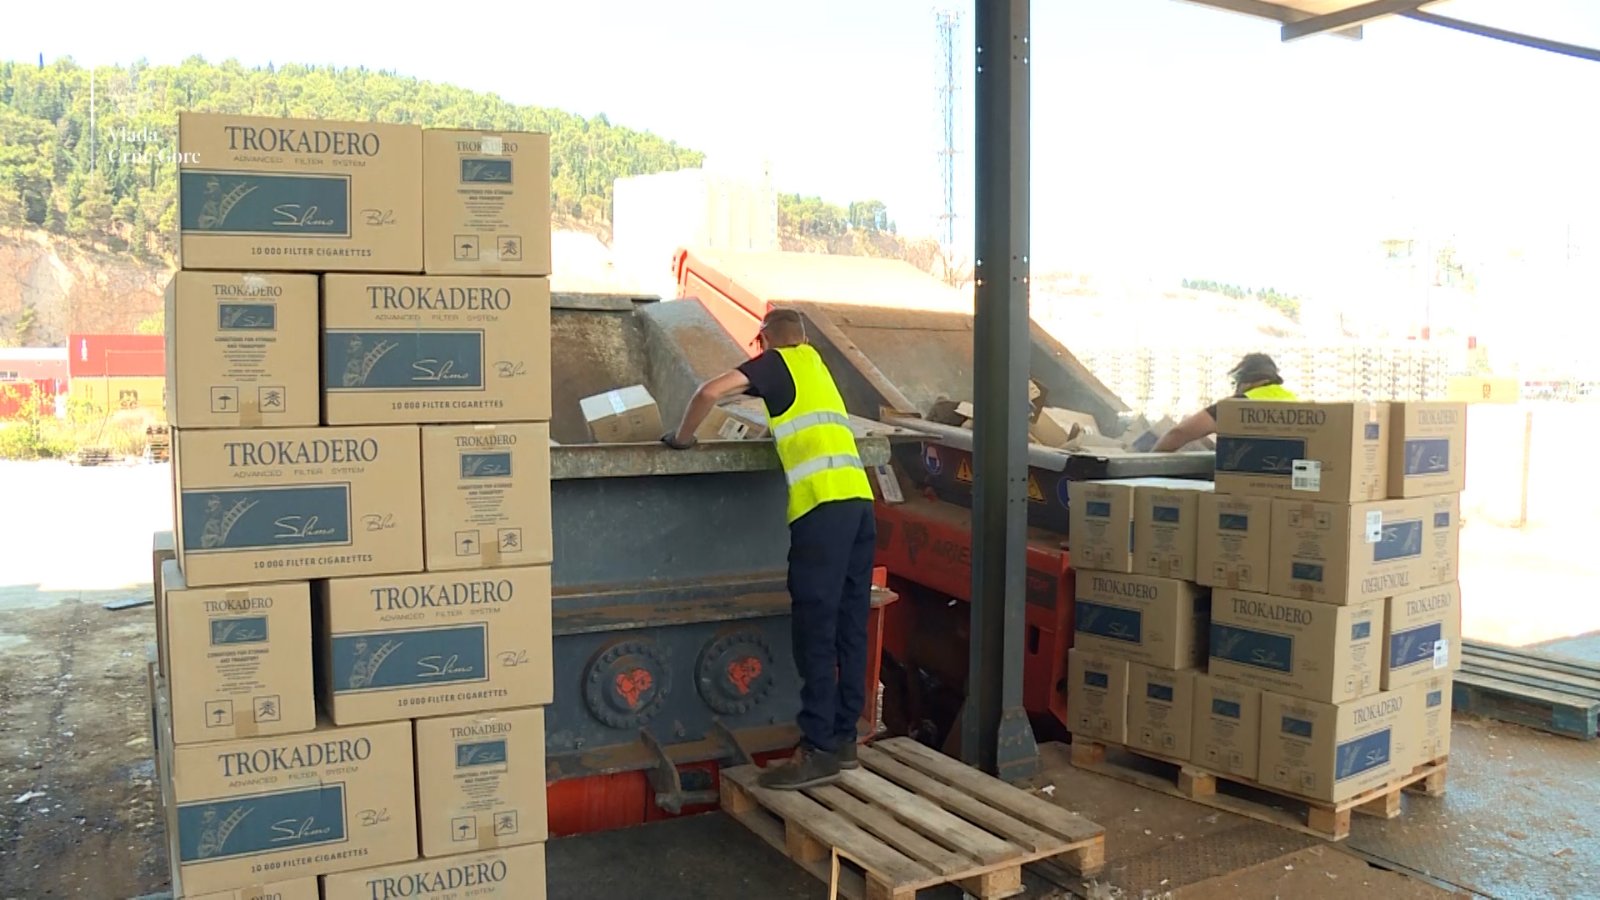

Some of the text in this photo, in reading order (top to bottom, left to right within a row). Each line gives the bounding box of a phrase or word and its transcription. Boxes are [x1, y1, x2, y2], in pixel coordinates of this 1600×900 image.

[224, 126, 380, 156] TROKADERO
[284, 248, 314, 256] FILTER
[316, 248, 372, 257] CIGARETTES
[212, 284, 282, 296] TROKADERO
[366, 286, 511, 310] TROKADERO
[392, 402, 402, 410] 10
[452, 400, 503, 408] CIGARETTES
[1238, 408, 1326, 426] TROKADERO
[454, 434, 516, 446] TROKADERO
[224, 438, 378, 466] TROKADERO
[286, 558, 316, 566] FILTER
[318, 554, 372, 565] CIGARETTES
[371, 580, 513, 610] TROKADERO
[1092, 577, 1158, 600] TROKADERO
[203, 597, 273, 612] TROKADERO
[1232, 598, 1312, 626] TROKADERO
[428, 694, 454, 703] FILTER
[458, 690, 508, 700] CIGARETTES
[1353, 696, 1403, 725] TROKADERO
[450, 722, 512, 738] TROKADERO
[218, 738, 371, 776] TROKADERO
[283, 858, 312, 868] FILTER
[315, 849, 368, 862] CIGARETTES
[366, 860, 507, 900] TROKADERO
